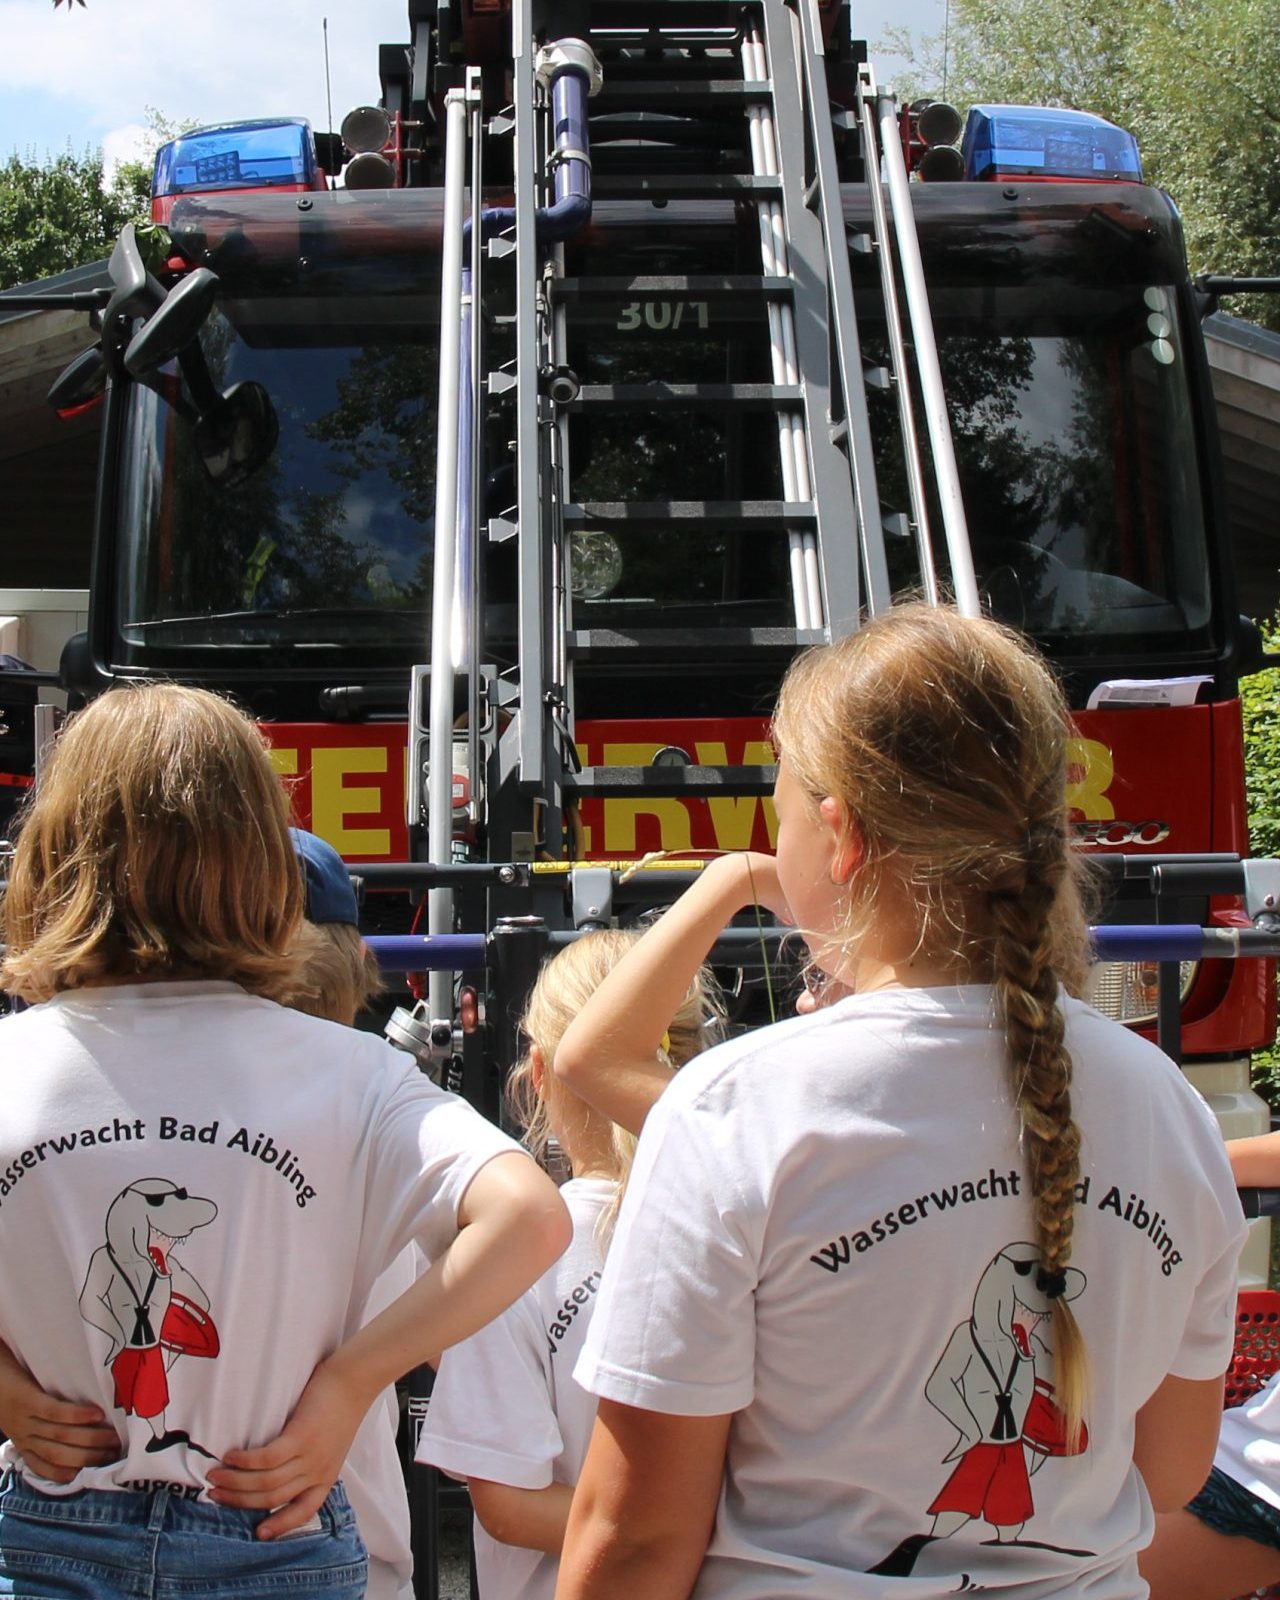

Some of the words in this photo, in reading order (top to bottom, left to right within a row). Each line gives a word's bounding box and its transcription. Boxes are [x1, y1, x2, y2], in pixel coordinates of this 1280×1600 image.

[158, 1116, 220, 1145] Bad
[226, 1127, 317, 1209] Aibling
[810, 1168, 1021, 1274] Wasserwacht
[1097, 1185, 1183, 1277] Aibling
